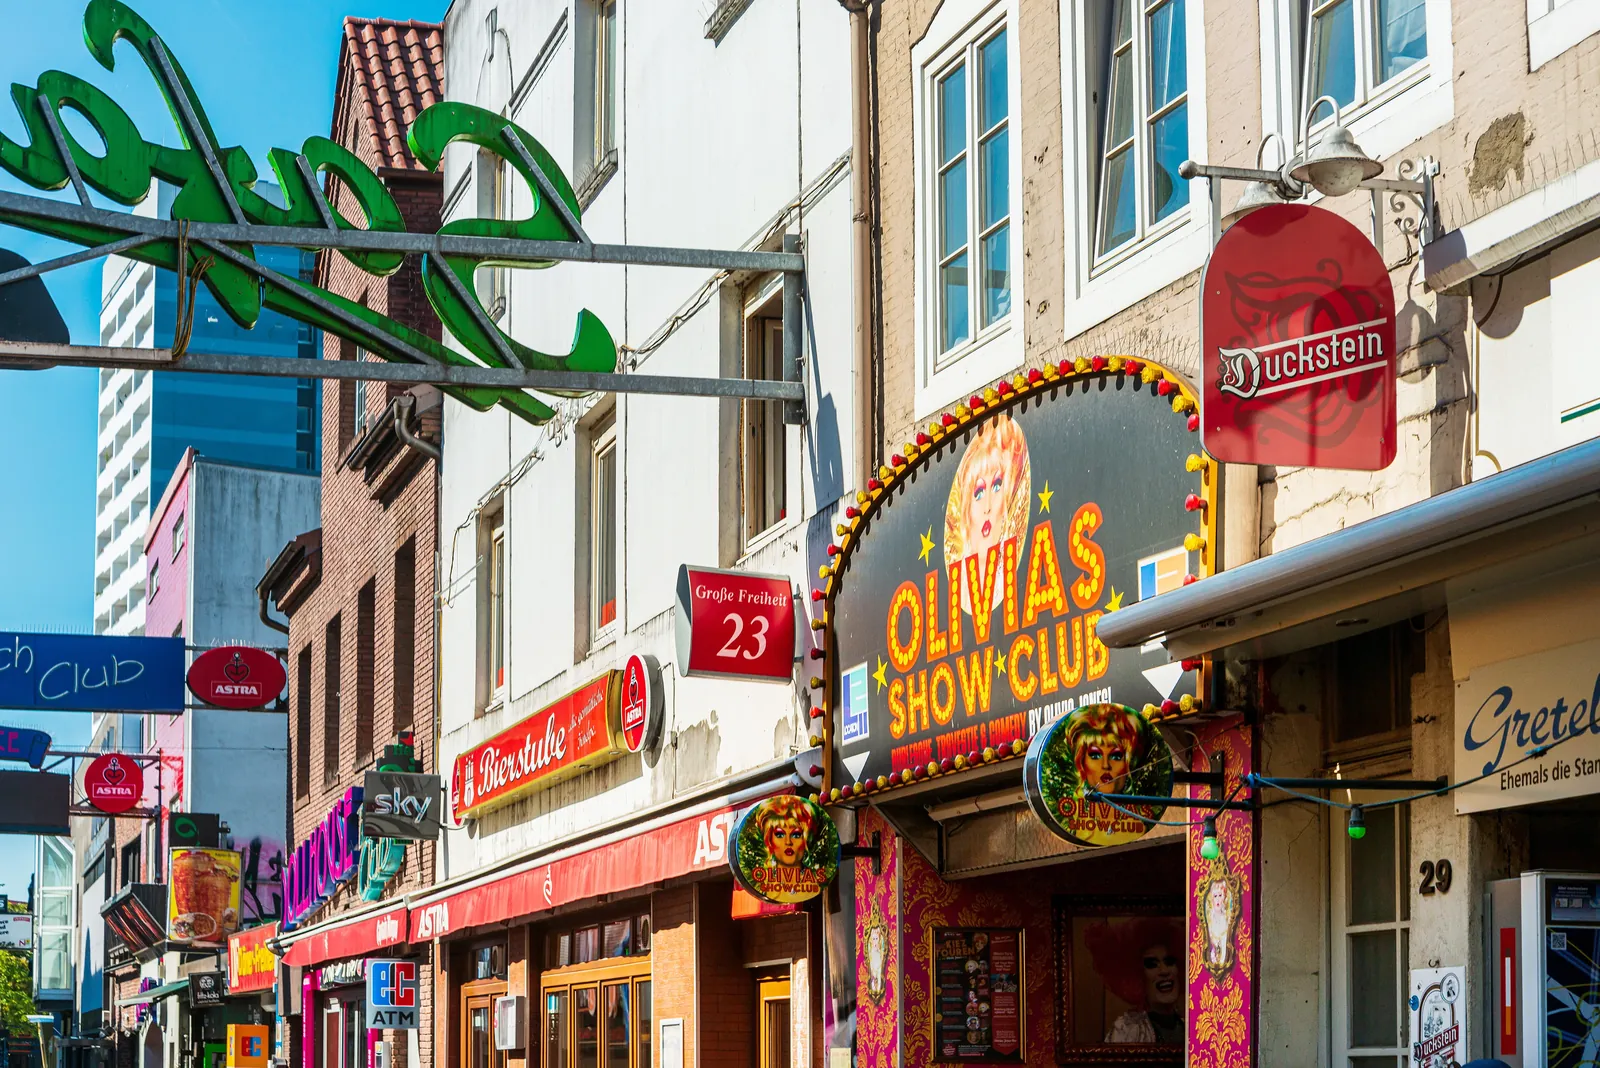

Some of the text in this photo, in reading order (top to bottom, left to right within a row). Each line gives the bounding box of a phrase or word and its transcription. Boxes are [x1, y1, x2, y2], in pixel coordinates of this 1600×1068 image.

[1216, 326, 1384, 400] Duckstein
[695, 583, 788, 608] Große Freiheit
[887, 501, 1107, 673] OLIVIAS
[716, 612, 770, 661] 23
[39, 654, 145, 700] Club
[215, 684, 258, 696] ASTRA
[888, 609, 1110, 740] SHOW CLUB
[626, 704, 642, 725] ASTRA
[1028, 706, 1042, 737] BY
[1464, 672, 1600, 777] Gretel
[477, 712, 568, 796] Bierstube
[96, 786, 132, 796] ASTRA
[1500, 762, 1549, 791] Ehemals
[1552, 759, 1571, 782] die
[374, 786, 433, 824] sky
[1057, 797, 1155, 821] OLIVIAS
[693, 810, 739, 866] AST
[751, 866, 828, 884] OLIVIAS
[1418, 859, 1452, 896] 29
[417, 901, 449, 939] ASTRA
[372, 1010, 415, 1026] ATM
[1413, 1028, 1458, 1062] Duckstein
